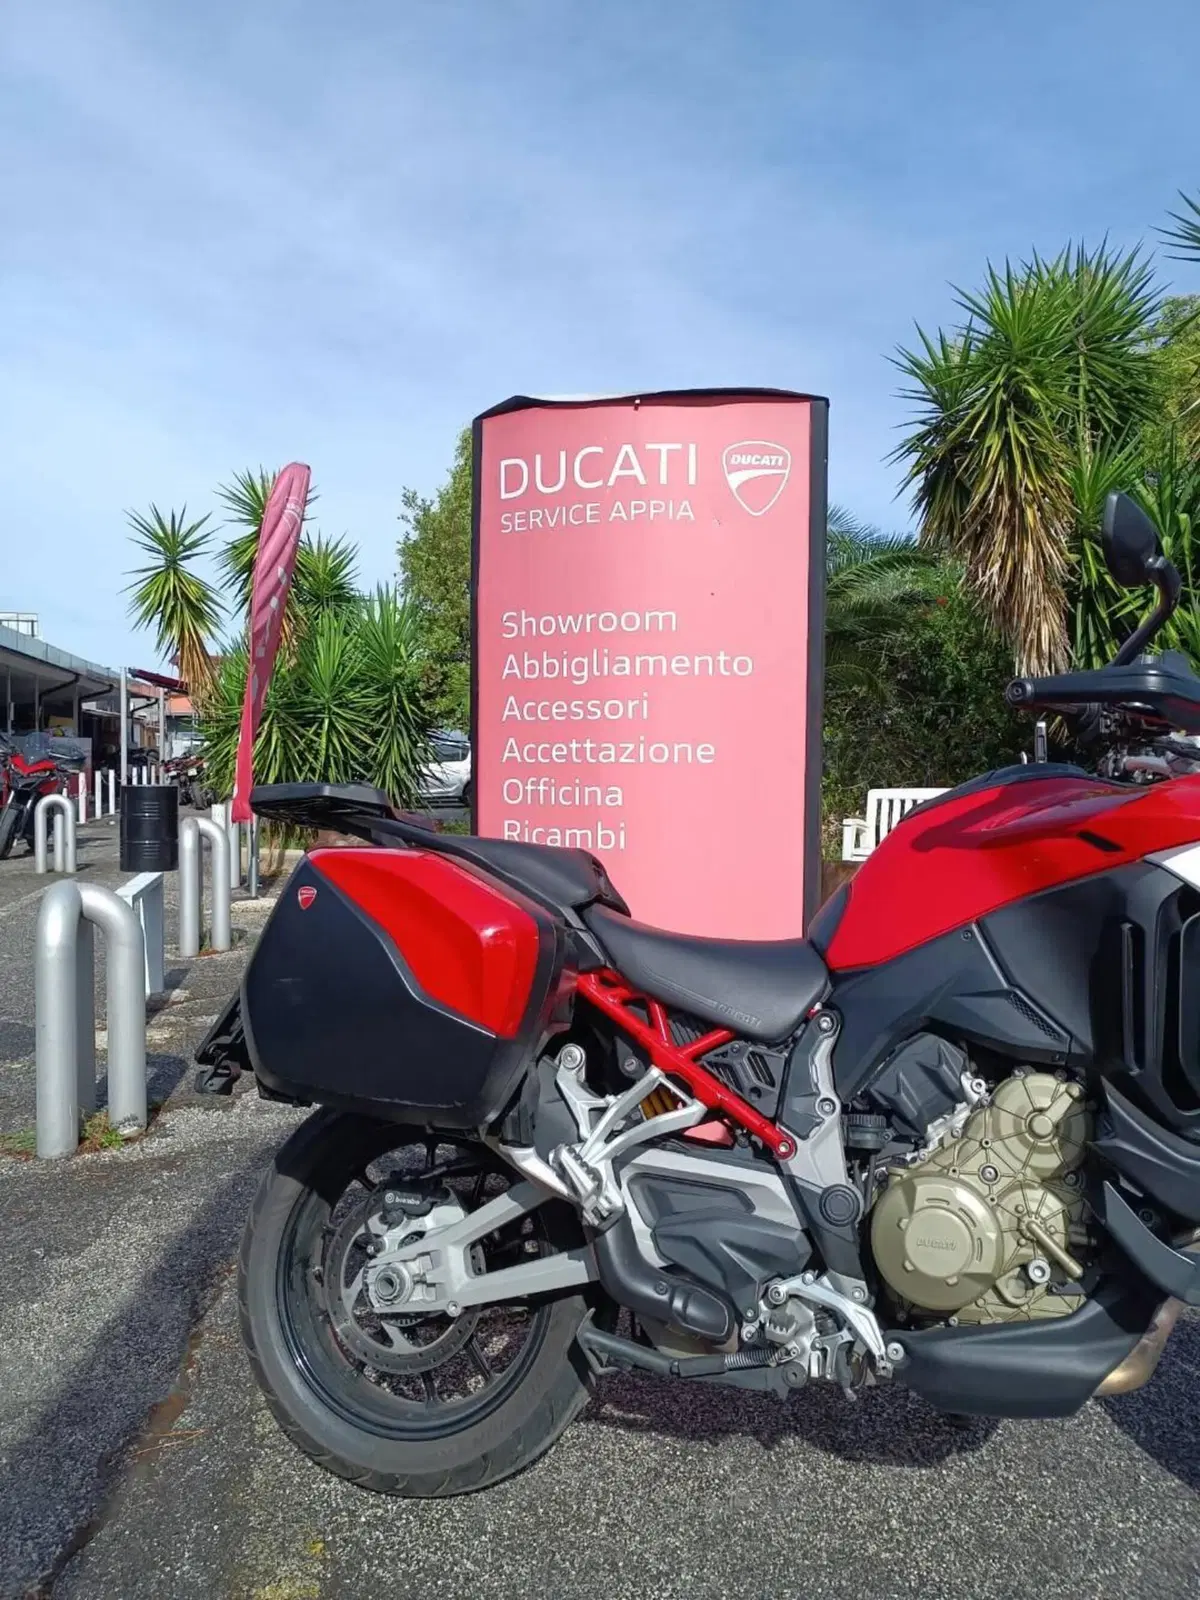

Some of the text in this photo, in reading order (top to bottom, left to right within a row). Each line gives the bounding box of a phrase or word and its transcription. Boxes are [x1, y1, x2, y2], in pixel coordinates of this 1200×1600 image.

[500, 443, 697, 500] DUCATI
[730, 454, 783, 466] DUCATI
[500, 500, 695, 533] SERVICE APPIA
[502, 609, 677, 638] Showroom
[502, 648, 754, 685] Abbigliamento
[502, 692, 649, 721] Accessori
[502, 736, 716, 763] Accettazione
[502, 777, 624, 806] Officina
[503, 819, 626, 850] Ricambi
